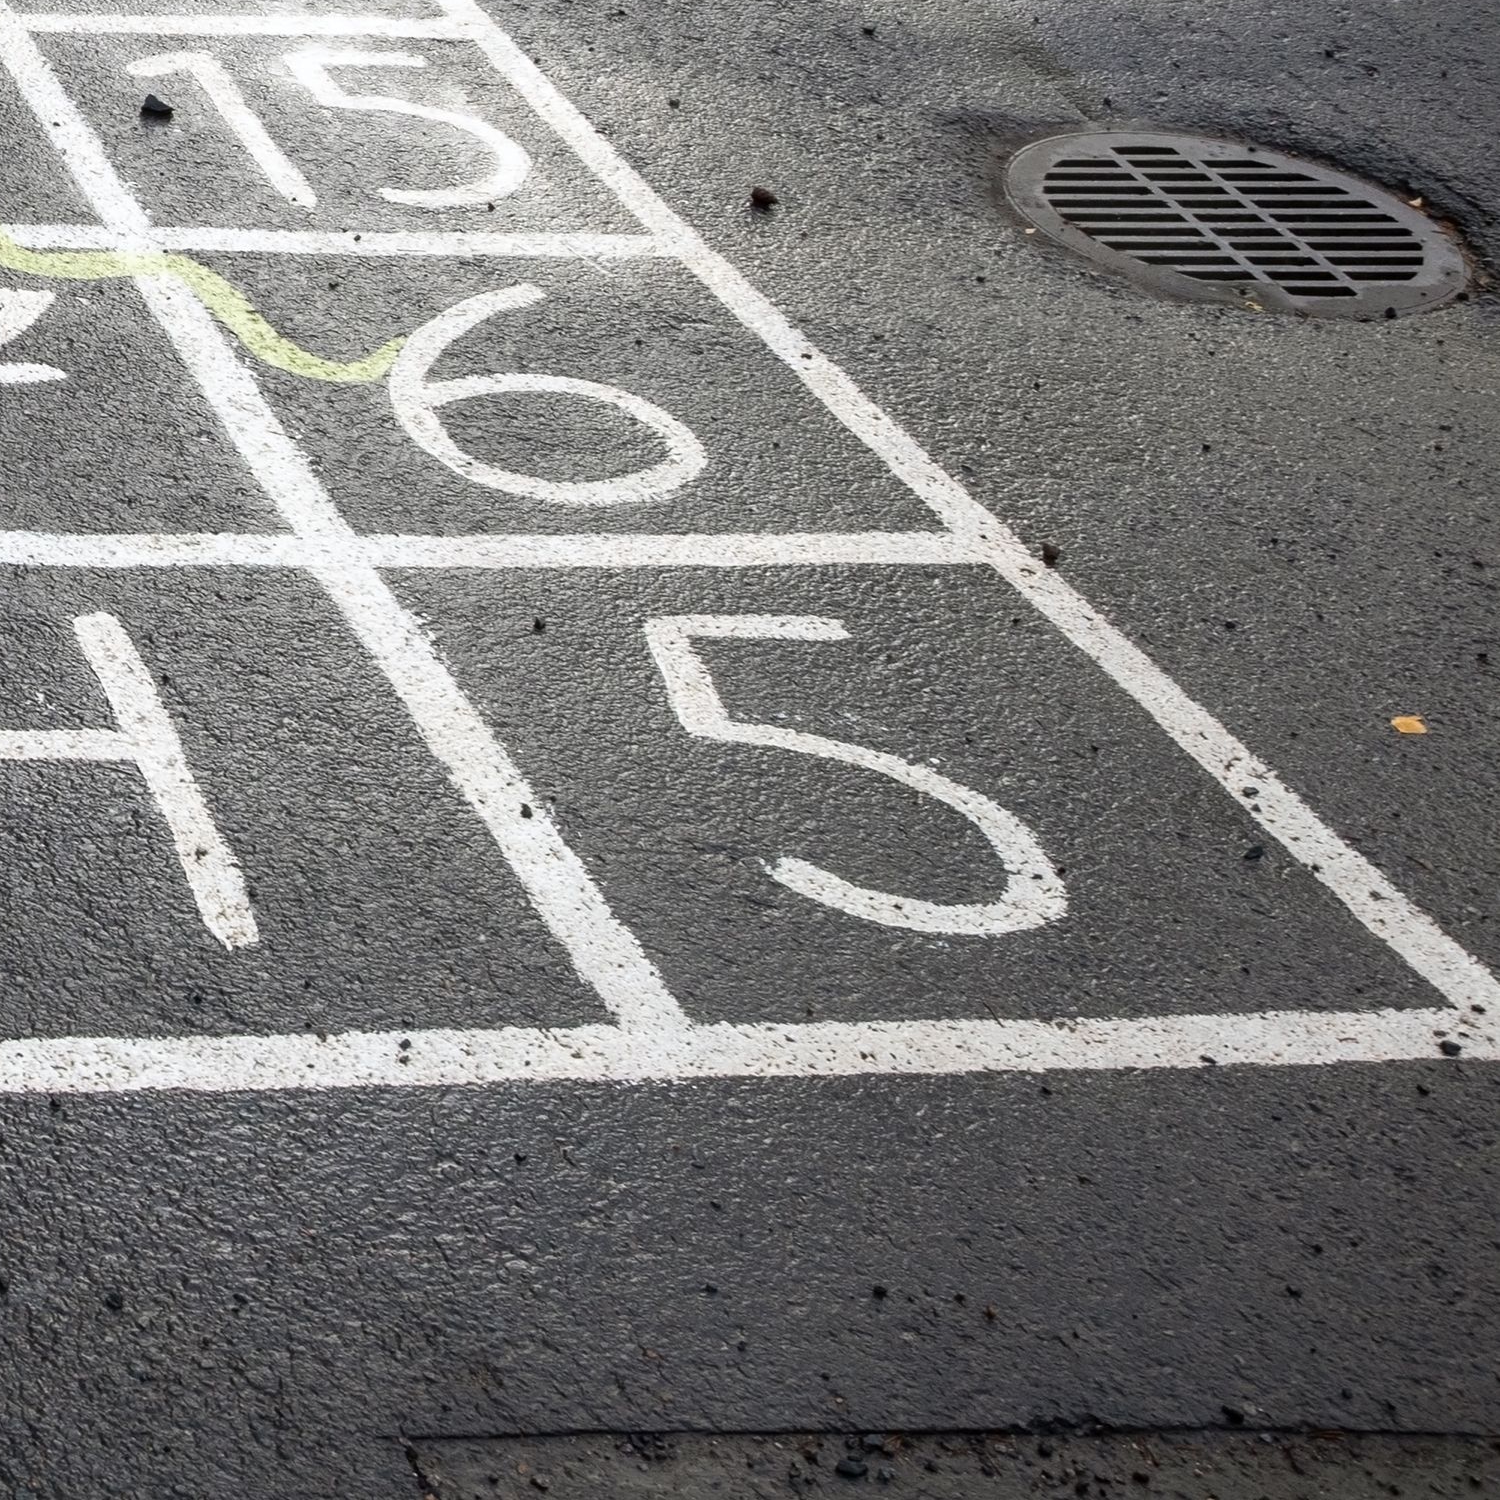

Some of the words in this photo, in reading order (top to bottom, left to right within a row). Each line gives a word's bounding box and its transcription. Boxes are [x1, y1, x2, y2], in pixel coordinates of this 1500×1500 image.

[126, 48, 530, 209] 15
[388, 283, 709, 503] 6
[642, 616, 1069, 936] 5
